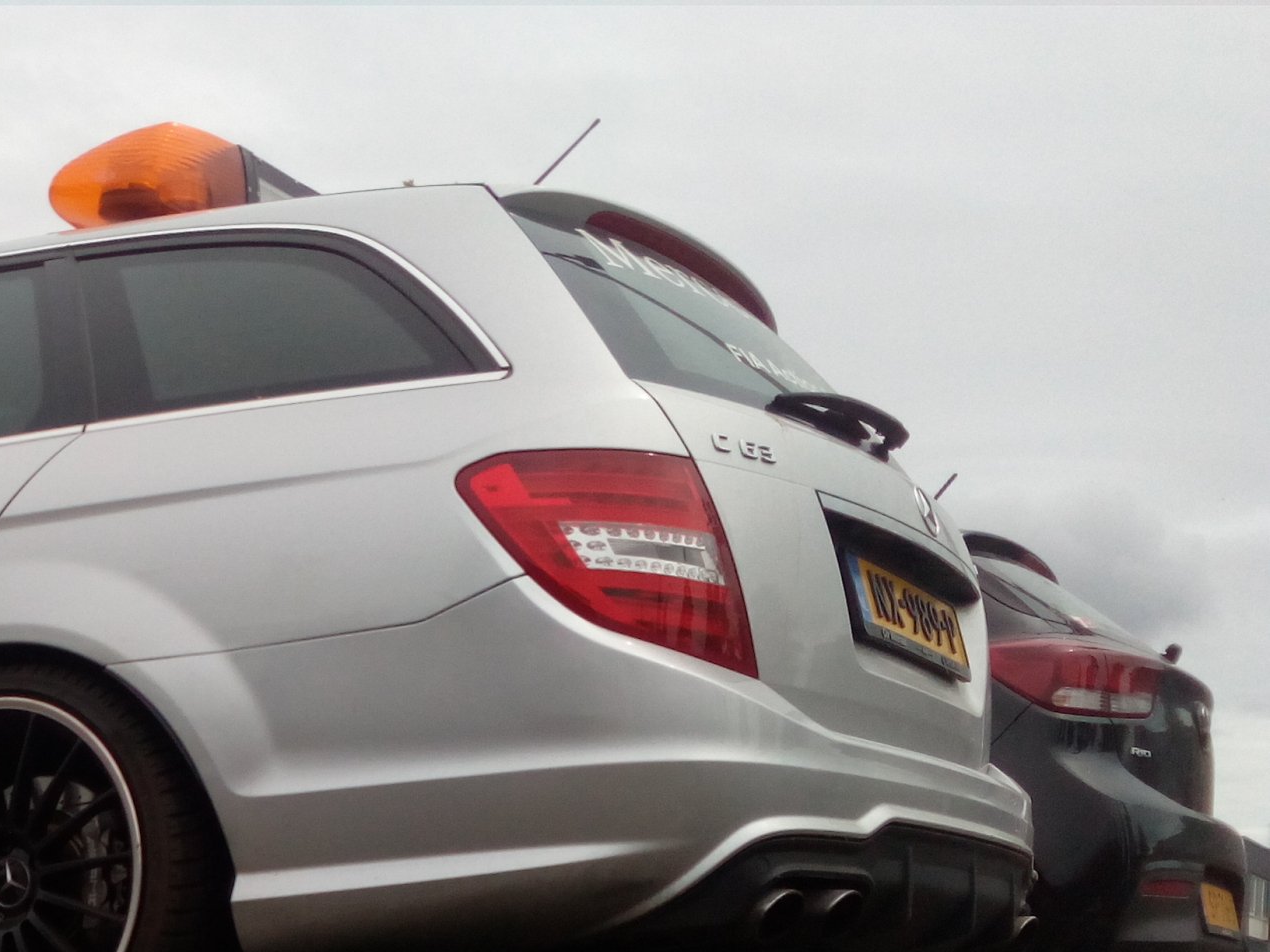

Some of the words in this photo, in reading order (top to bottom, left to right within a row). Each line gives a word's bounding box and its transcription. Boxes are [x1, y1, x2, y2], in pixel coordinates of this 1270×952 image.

[724, 341, 772, 374] FIA
[711, 431, 731, 453] C
[738, 438, 777, 465] 63
